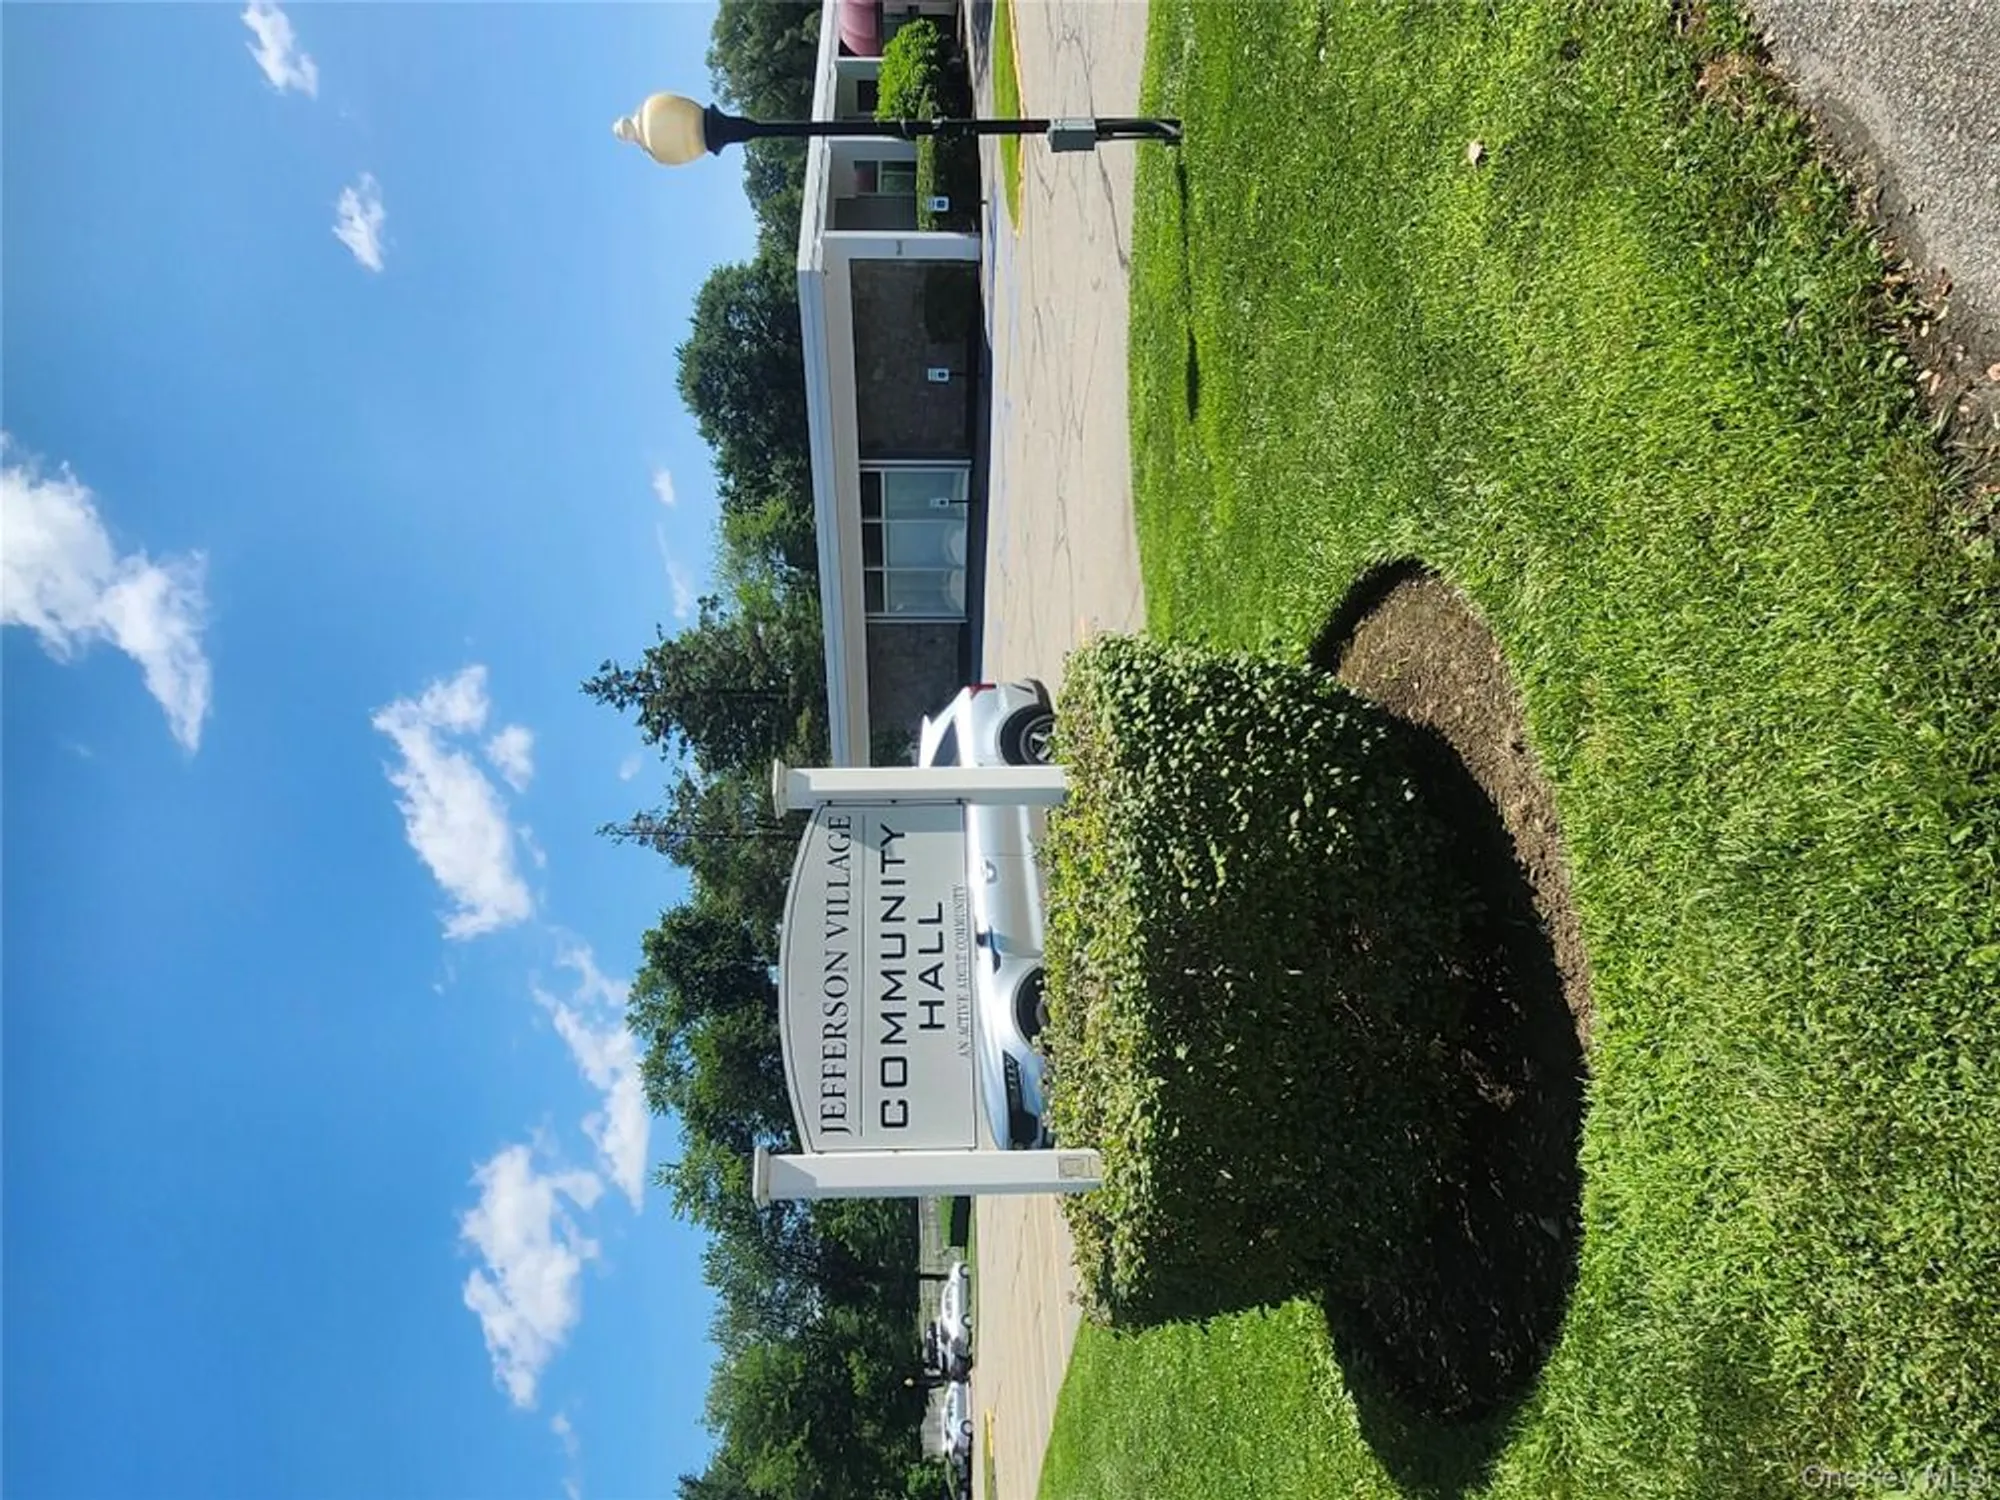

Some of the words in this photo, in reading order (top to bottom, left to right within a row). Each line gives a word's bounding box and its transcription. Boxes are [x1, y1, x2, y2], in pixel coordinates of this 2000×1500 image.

[825, 815, 852, 940] VILLAGE
[952, 883, 967, 951] COMMUNITY
[880, 823, 908, 1128] COMMUNITY
[918, 902, 945, 1030] HALL
[955, 954, 968, 989] ADULT
[820, 949, 852, 1136] JEFFERSON
[956, 994, 970, 1036] ACTIVE
[957, 1040, 970, 1058] AN
